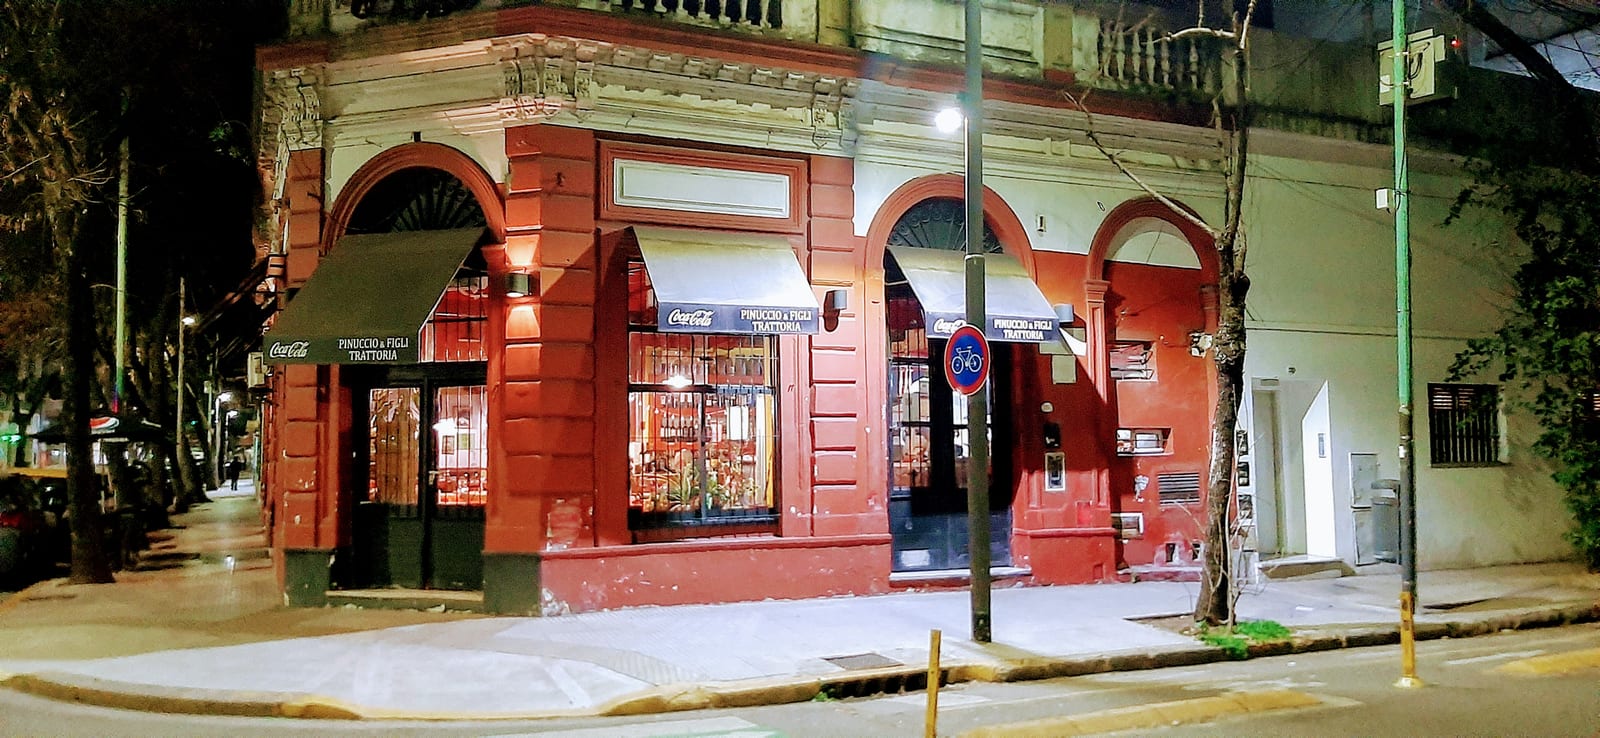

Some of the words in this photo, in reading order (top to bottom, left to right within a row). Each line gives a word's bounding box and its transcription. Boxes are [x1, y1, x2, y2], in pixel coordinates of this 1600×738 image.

[740, 309, 781, 320] PINUCCIO
[783, 312, 789, 320] &
[790, 310, 812, 321] FIGLI
[752, 321, 801, 332] TRATTORIA
[994, 319, 1028, 330] PINUCCIO
[1034, 320, 1053, 330] FIGLI
[1003, 329, 1044, 340] TRATTORIA
[338, 338, 379, 349] PINUCCIO
[379, 340, 385, 349] &
[386, 337, 409, 348] FIGLI
[349, 350, 398, 361] TRATTORIA
